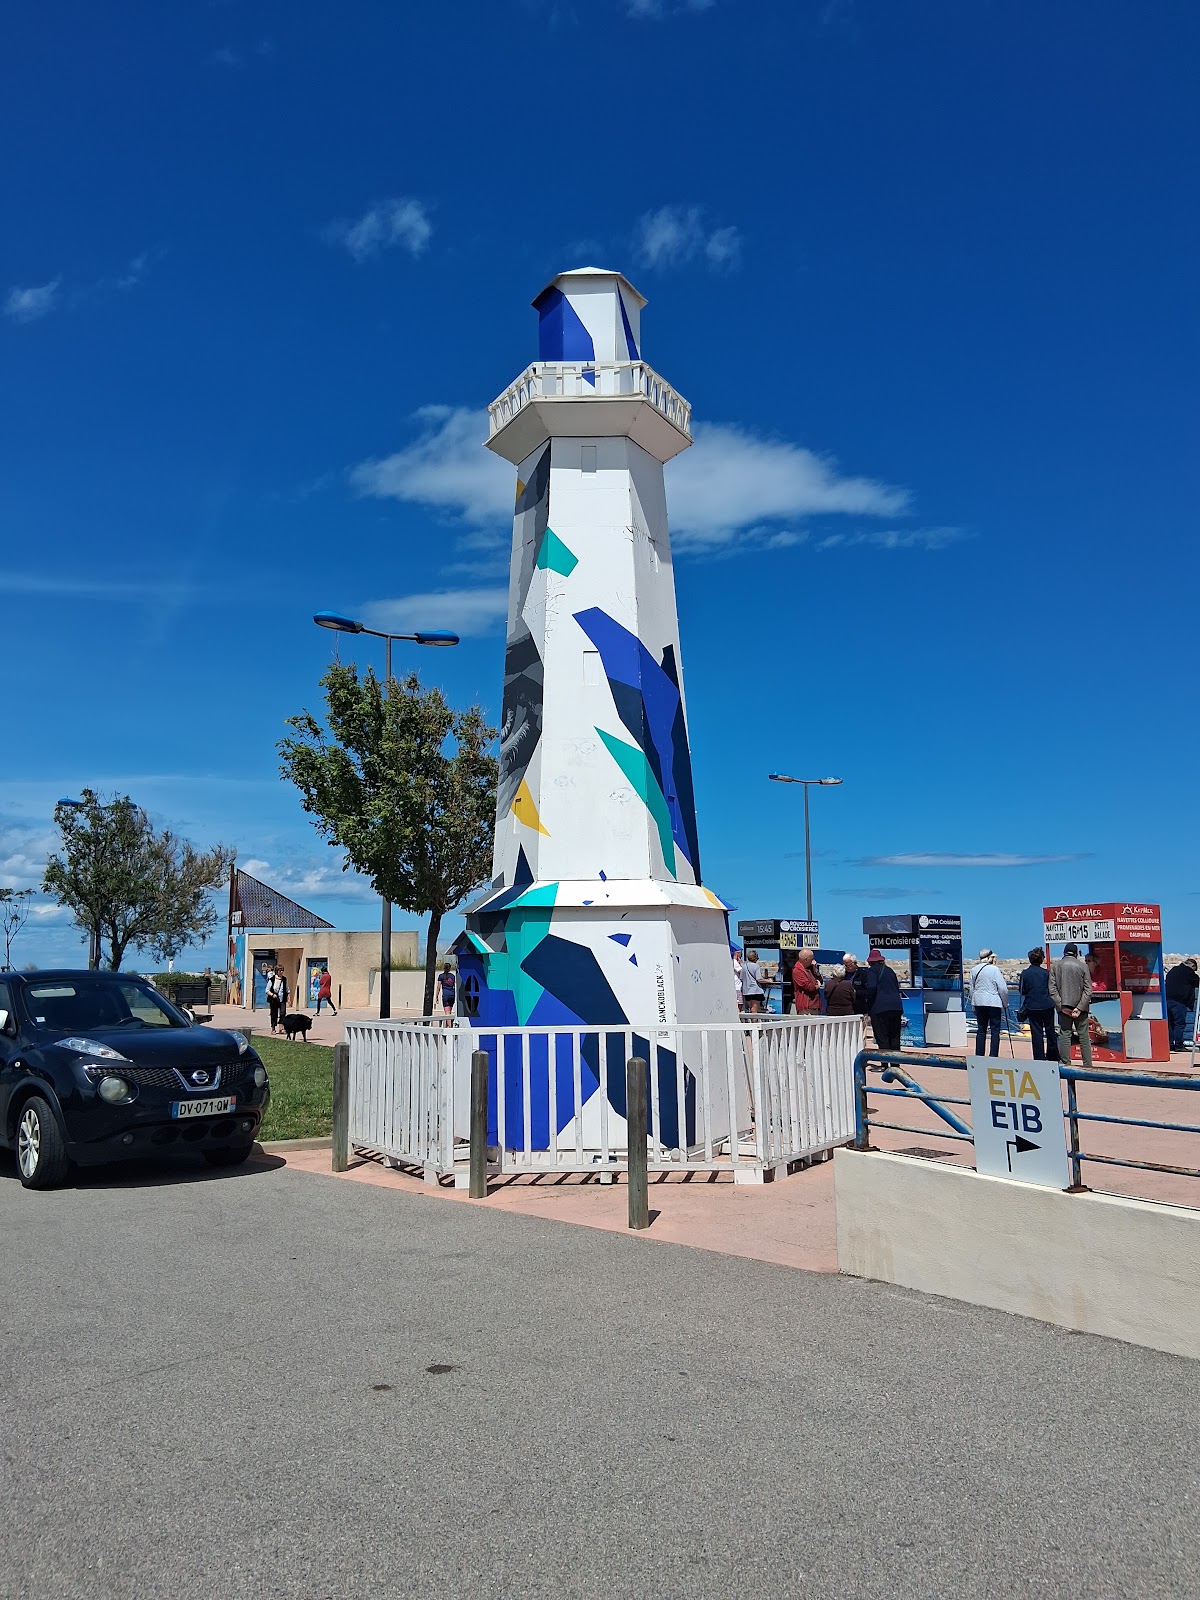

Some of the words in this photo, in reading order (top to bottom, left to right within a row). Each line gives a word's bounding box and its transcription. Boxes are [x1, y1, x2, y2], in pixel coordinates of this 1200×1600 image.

[1046, 924, 1064, 932] NAVETTE
[1094, 921, 1109, 929] PETITE
[1045, 933, 1066, 941] COLLIOURE
[1094, 931, 1111, 939] BALADE
[885, 936, 920, 945] Croisières
[987, 1068, 1041, 1100] E1A
[990, 1100, 1043, 1133] E1B
